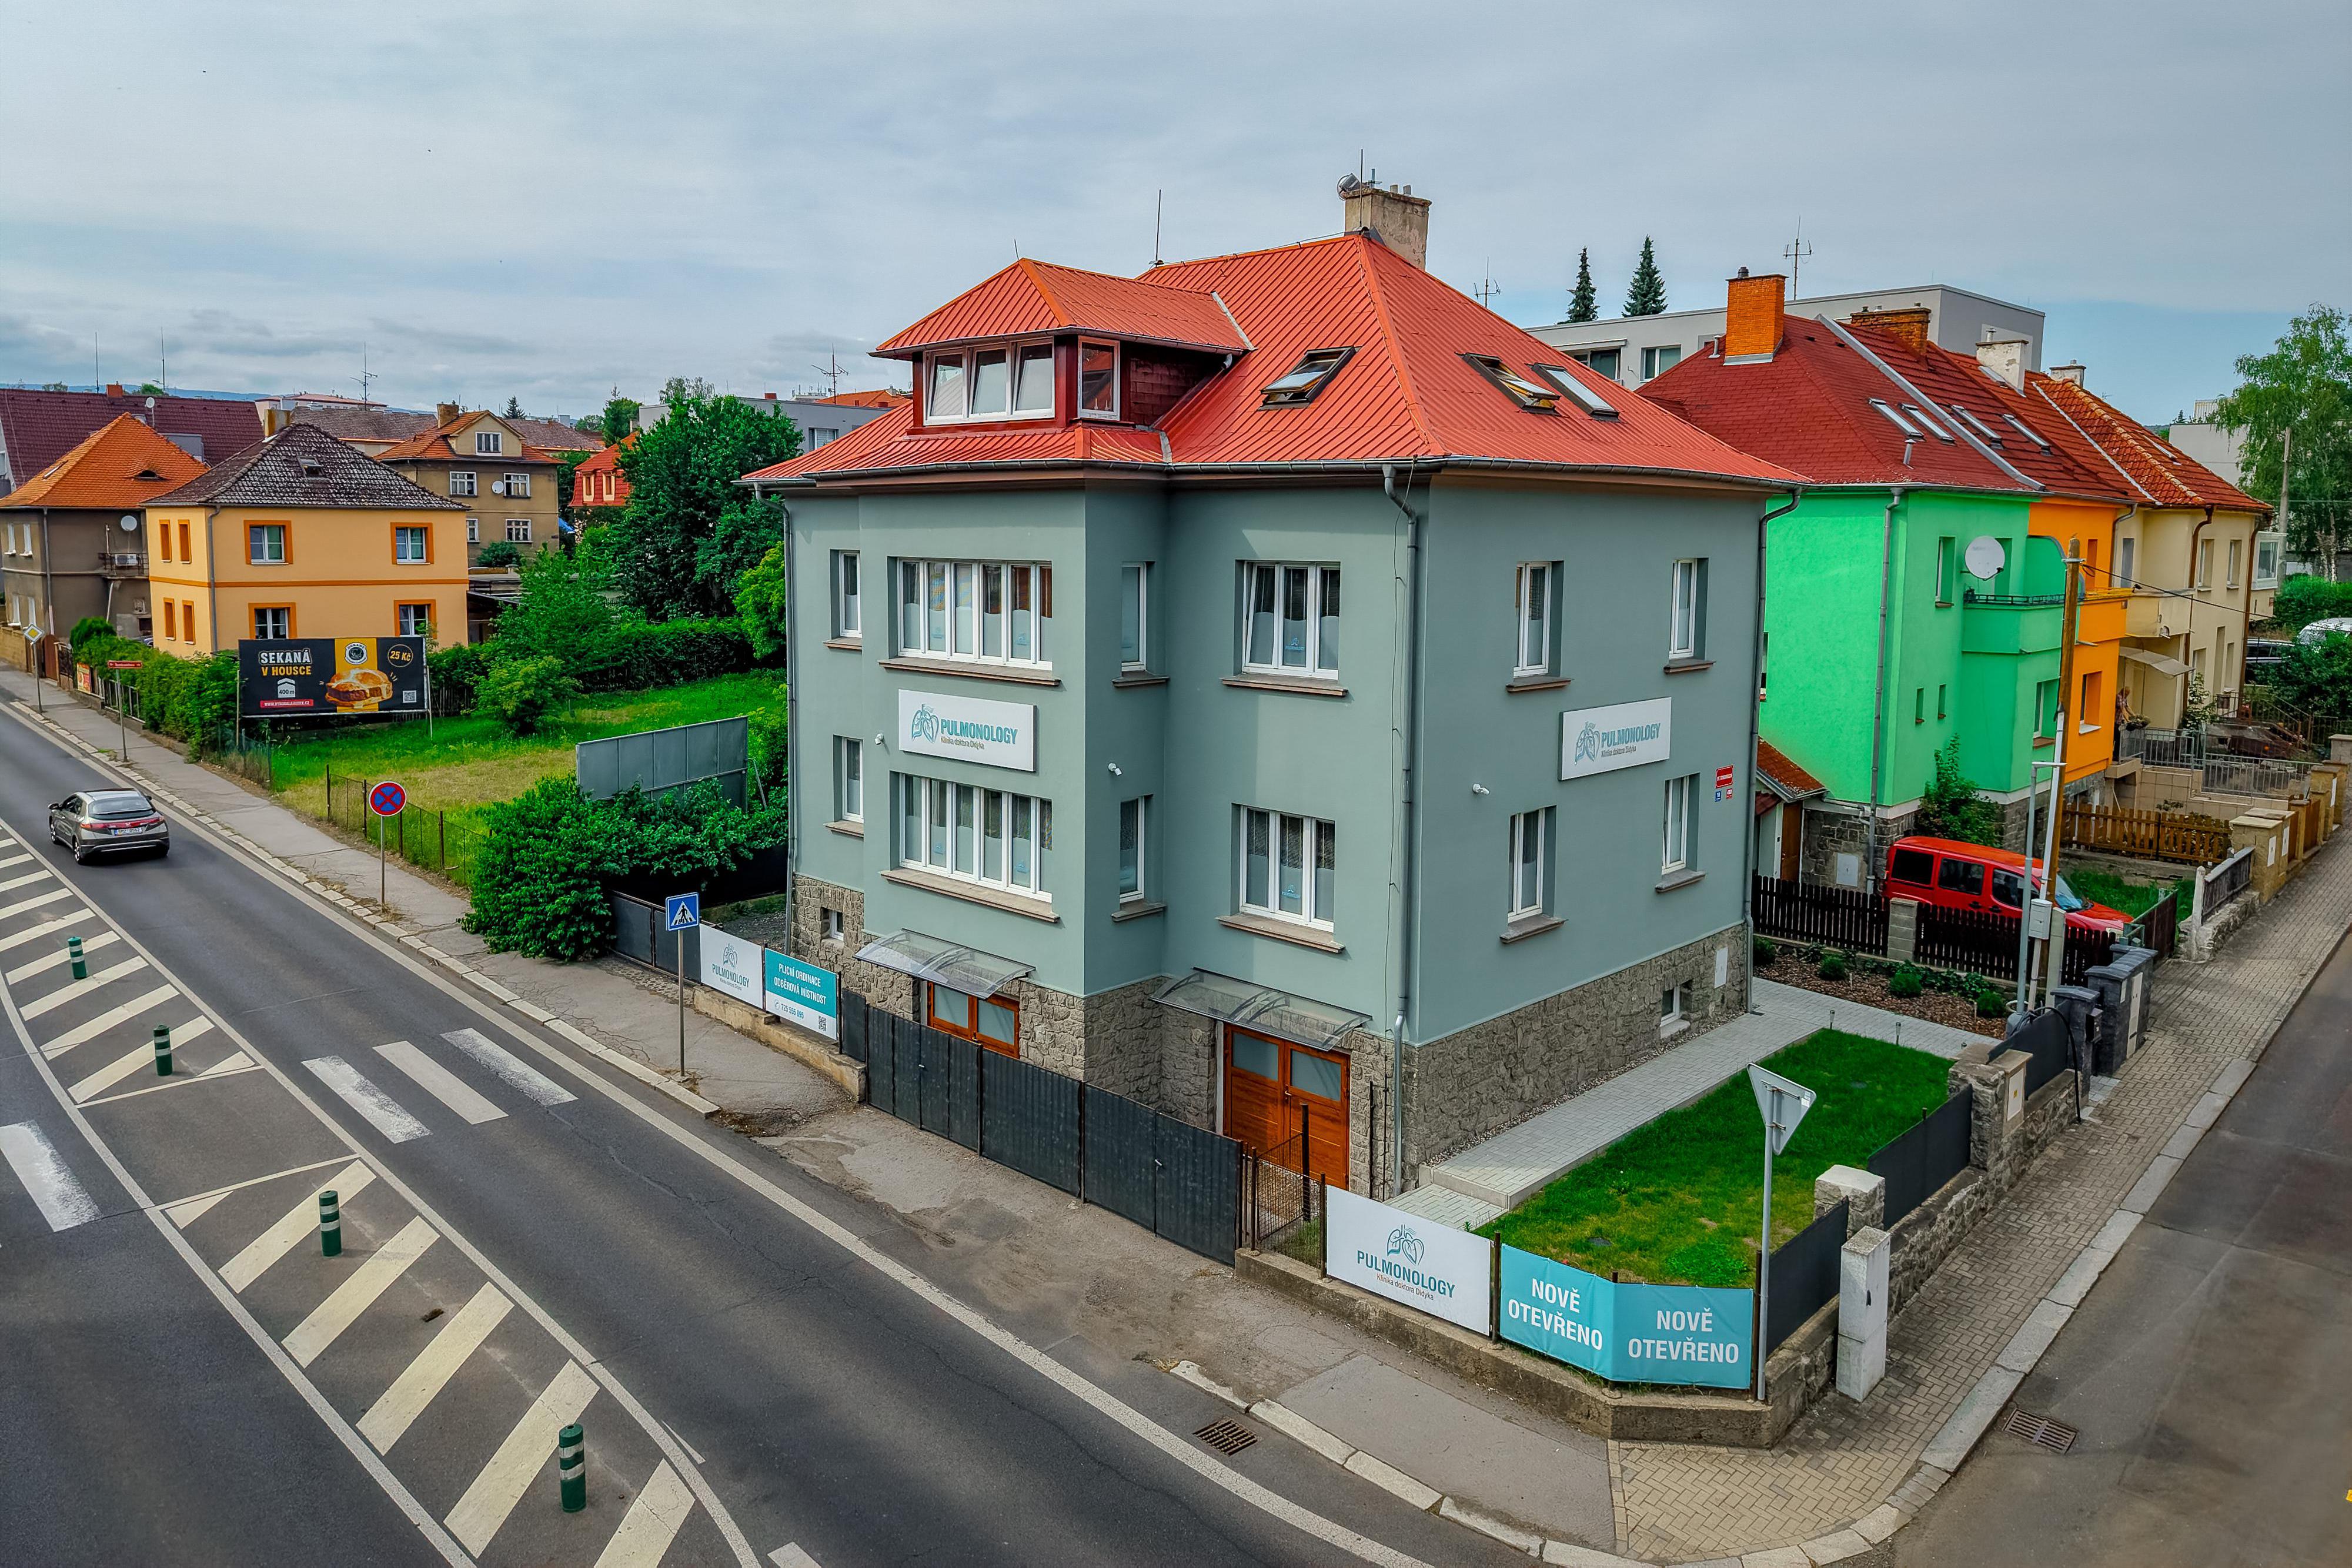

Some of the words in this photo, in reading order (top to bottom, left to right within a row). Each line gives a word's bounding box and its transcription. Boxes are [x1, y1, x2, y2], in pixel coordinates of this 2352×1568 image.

[260, 649, 310, 664] SEKANÁ
[390, 651, 400, 659] 25
[261, 667, 268, 676] V
[272, 666, 311, 676] HOUSCE
[941, 718, 1018, 744] PULMONOLOGY
[1601, 723, 1661, 748] PULMONOLOGY
[712, 964, 750, 988] PULMONOLOGY
[779, 963, 795, 978] PLICNÍ
[796, 970, 821, 987] ORDINACE
[774, 977, 800, 995] ODBĚROVÁ
[801, 987, 827, 1005] MÍSTNOST
[1357, 1250, 1455, 1298] PULMONOLOGY
[1377, 1273, 1394, 1286] Klinika
[1395, 1281, 1414, 1293] doktora
[1416, 1288, 1434, 1300] Didyka
[1531, 1278, 1581, 1313] NOVĚ
[1508, 1299, 1603, 1350] OTEVŘENO
[1656, 1308, 1713, 1332] NOVĚ
[1628, 1337, 1739, 1363] OTEVŘENO
